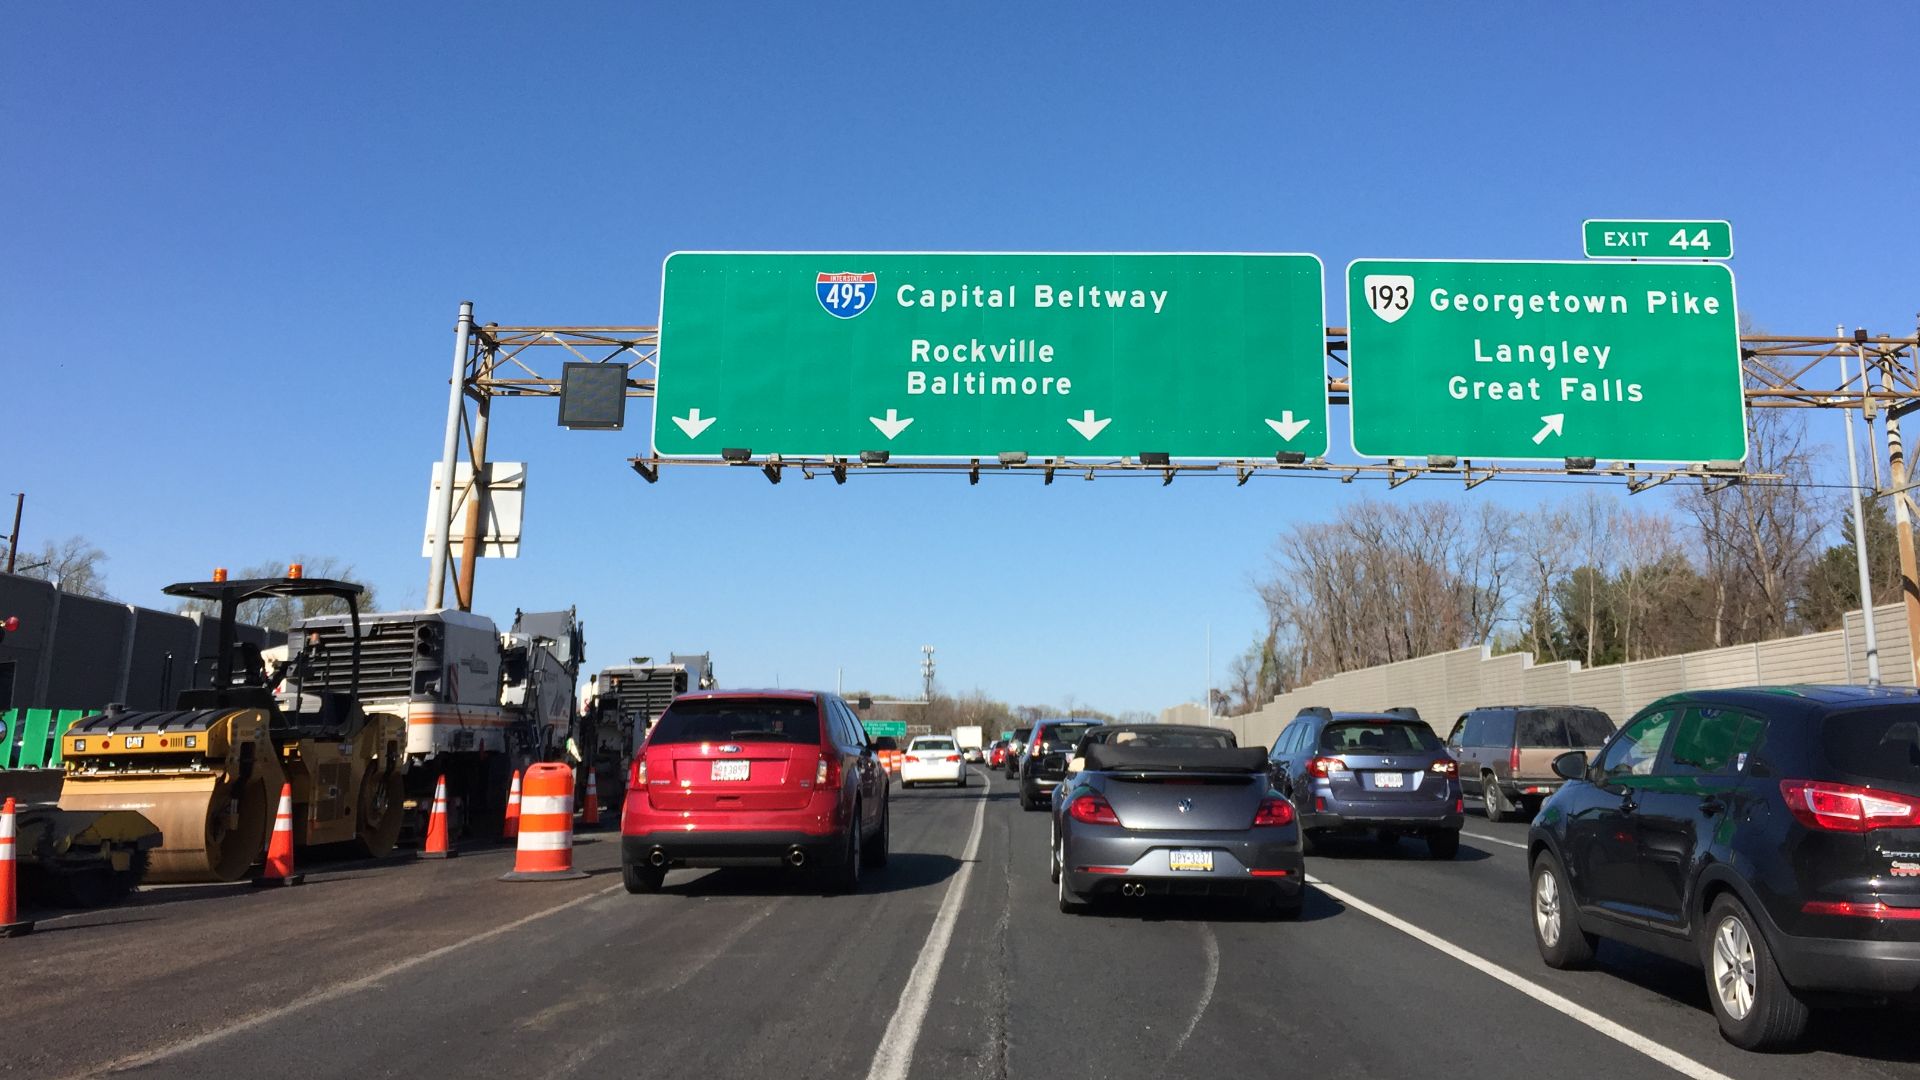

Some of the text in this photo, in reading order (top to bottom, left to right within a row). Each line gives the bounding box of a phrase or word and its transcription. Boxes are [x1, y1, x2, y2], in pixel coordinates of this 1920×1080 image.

[1604, 228, 1711, 251] EXIT 44
[825, 283, 866, 310] 495
[896, 284, 1168, 314] Capital Beltway
[1371, 285, 1409, 311] 193
[1430, 288, 1720, 320] Georgetown Pike
[911, 338, 1054, 363] Rockville
[1474, 339, 1611, 371] Langley
[907, 371, 1072, 395] Baltimore
[1448, 375, 1643, 402] Great Falls
[126, 736, 143, 748] CAT
